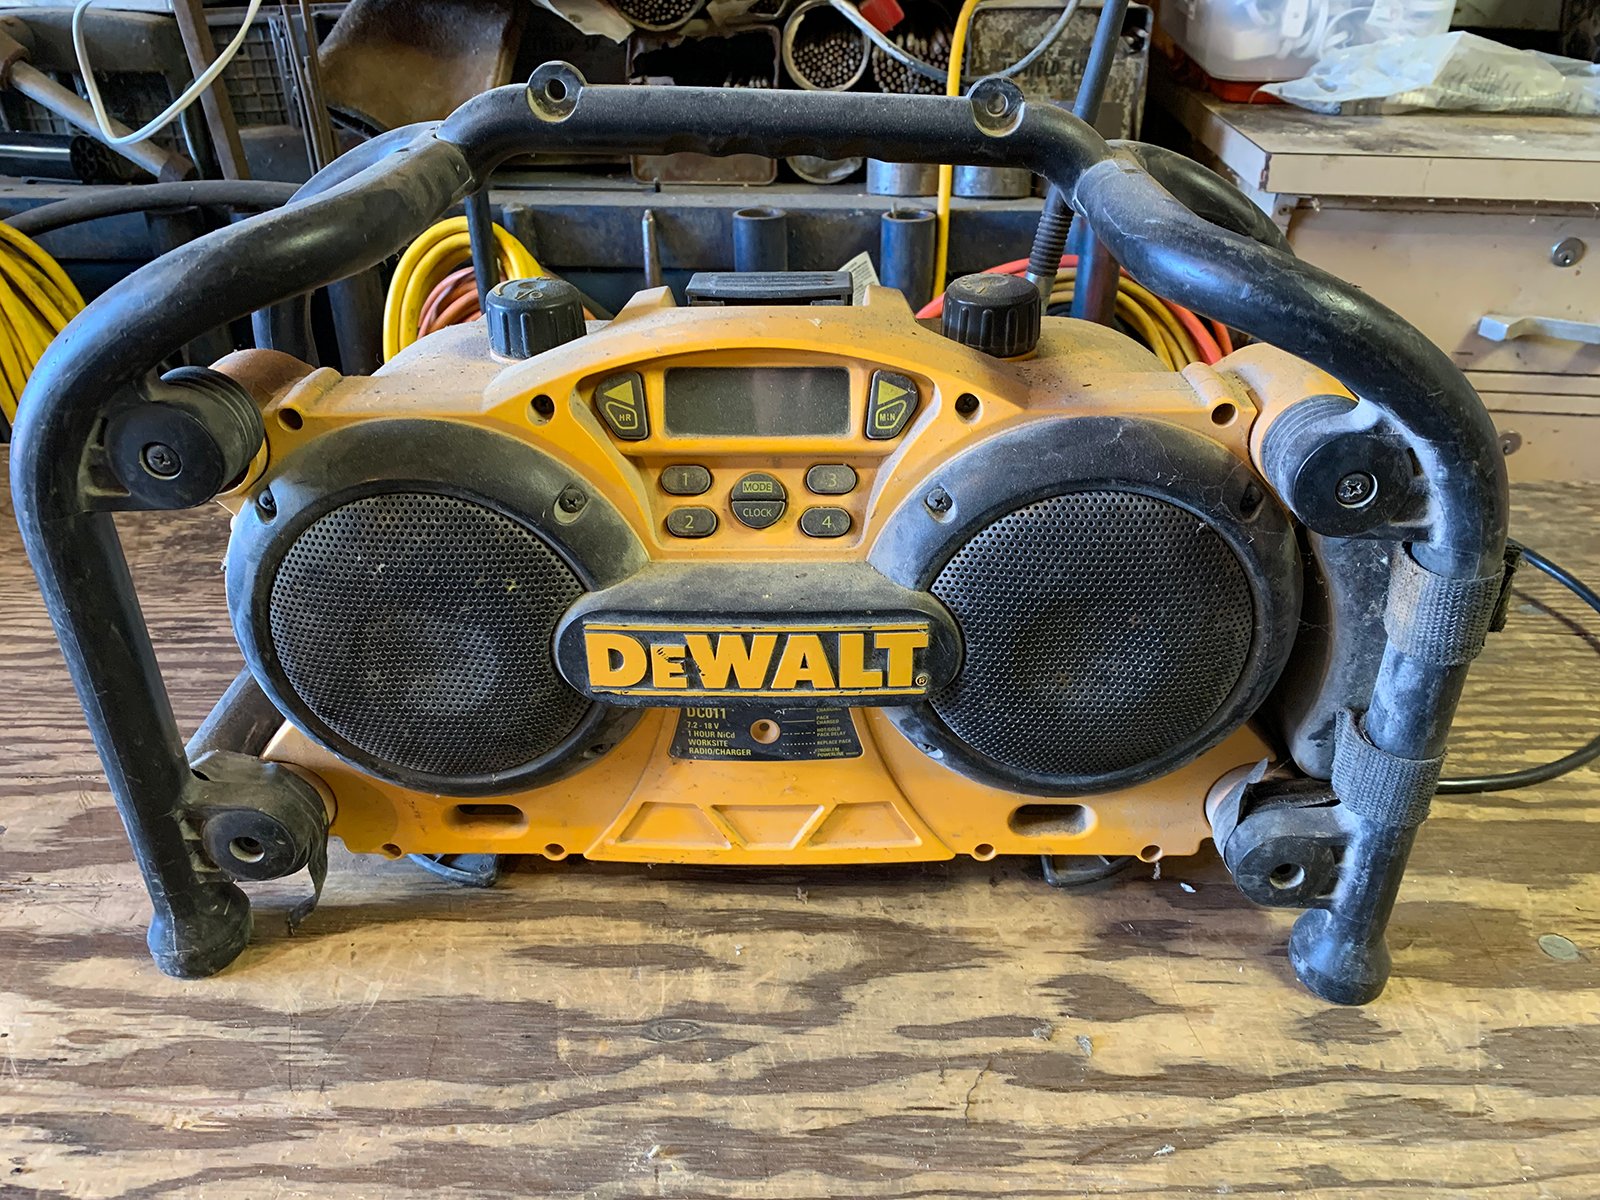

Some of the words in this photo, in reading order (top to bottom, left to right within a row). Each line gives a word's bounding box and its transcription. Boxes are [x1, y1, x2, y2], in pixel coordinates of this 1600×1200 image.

[618, 412, 632, 422] HR
[879, 412, 896, 422] MIN
[681, 472, 689, 486] 1
[827, 472, 838, 487] 3
[743, 482, 773, 493] MODE
[743, 507, 772, 518] CLOCK
[684, 515, 694, 529] 2
[821, 515, 832, 529] 4
[686, 707, 727, 719] DC011
[687, 721, 698, 729] 7.2
[717, 731, 736, 739] NiCd
[688, 739, 729, 747] WORKSITE
[688, 747, 752, 756] RADIO/CHARGER
